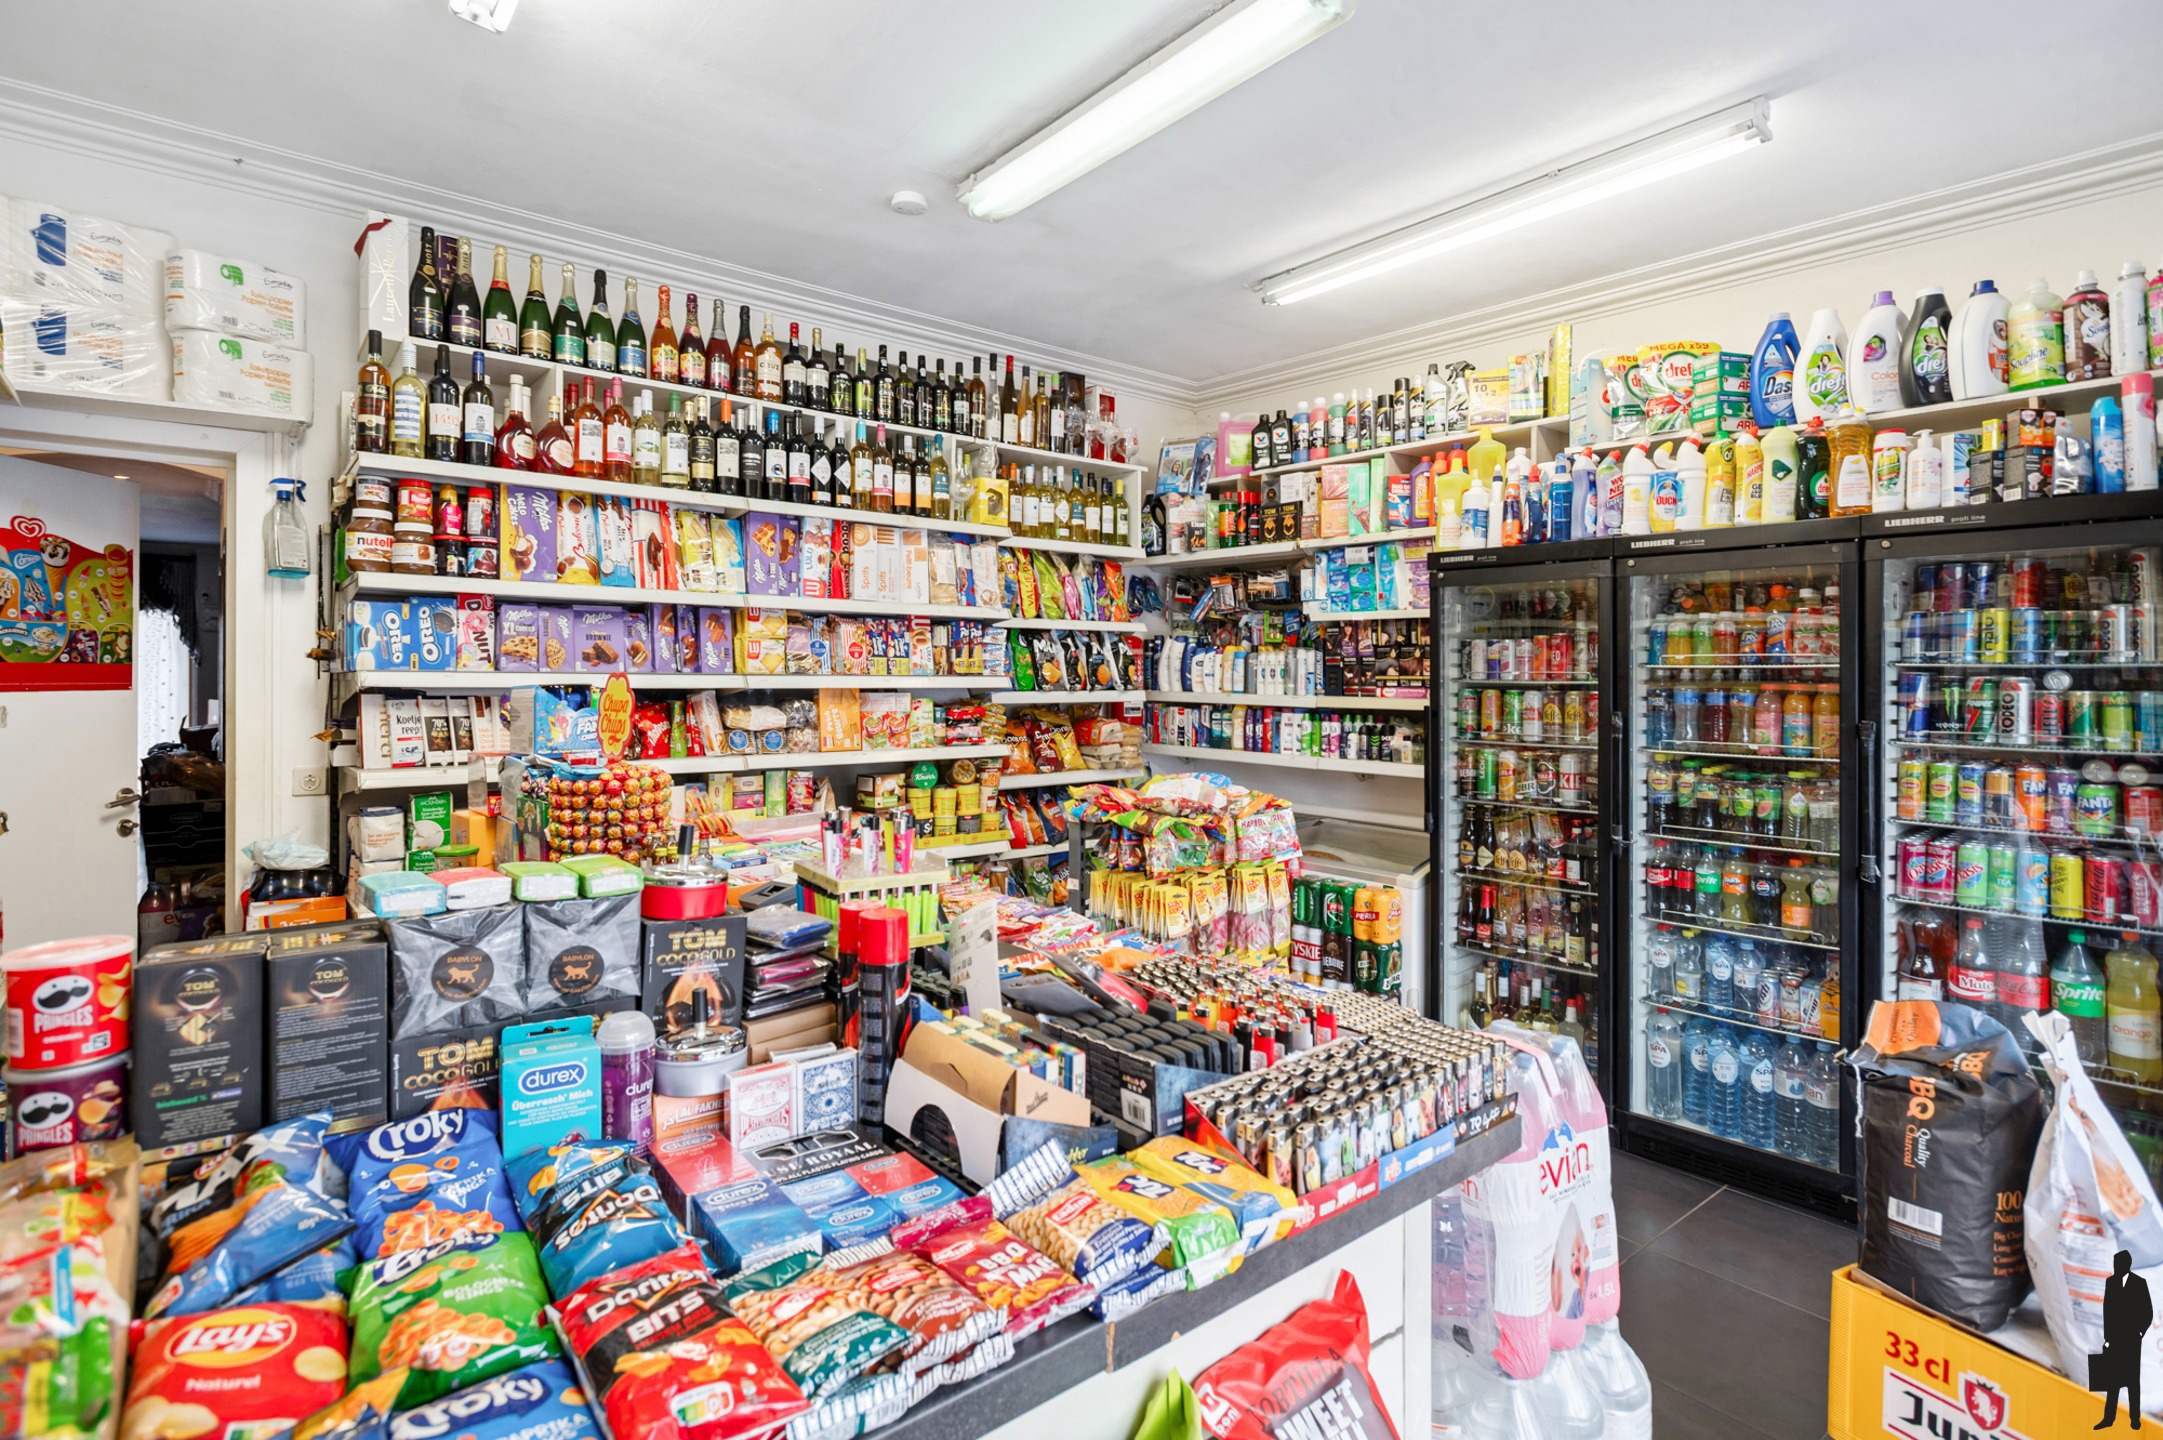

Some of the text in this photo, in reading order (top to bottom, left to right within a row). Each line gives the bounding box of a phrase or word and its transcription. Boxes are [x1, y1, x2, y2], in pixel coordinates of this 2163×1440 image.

[263, 277, 294, 290] Everyday
[262, 350, 291, 362] Everyday
[1650, 342, 1686, 351] MEGA
[759, 361, 780, 371] CRUZ
[1656, 496, 1677, 506] DUCK
[1884, 514, 1945, 528] LIEBHERR
[1631, 539, 1675, 549] LIEBHERR
[1440, 554, 1474, 564] LIEBHERR
[861, 566, 871, 590] Sprits
[382, 610, 403, 664] OREO
[418, 605, 438, 663] OREO
[603, 694, 628, 712] Chupa
[2001, 693, 2016, 735] RODEO
[431, 719, 448, 728] 70%
[600, 715, 627, 744] Chups
[2077, 796, 2114, 809] FANTA
[668, 928, 727, 952] TOM
[1291, 939, 1321, 960] YSKIE
[446, 955, 483, 964] BABYLON
[561, 953, 595, 963] BABYLON
[656, 948, 736, 967] COCOGOLD
[184, 980, 217, 992] TOM
[315, 969, 345, 981] TOM
[1958, 974, 1995, 992] Mate
[2055, 982, 2105, 1002] Sprite
[33, 1005, 95, 1034] PRINGLES
[2112, 1024, 2152, 1038] Orange
[417, 1036, 494, 1071] TOM
[1650, 1043, 1667, 1055] SPA
[403, 1058, 499, 1090] COCOGOL
[526, 1067, 581, 1091] durex
[569, 1088, 593, 1101] Mich
[18, 1122, 74, 1147] PRINGLES
[368, 1108, 465, 1161] Croky
[1903, 1124, 1917, 1168] Charcoal
[805, 1142, 878, 1167] ROYAAL
[1916, 1127, 1932, 1168] Quality
[800, 1161, 833, 1177] PLASTIC
[1180, 1151, 1223, 1175] TUC
[1539, 1141, 1591, 1196] evian
[562, 1167, 623, 1214] BITS
[1126, 1175, 1174, 1199] TUC
[1996, 1191, 2023, 1211] 100
[555, 1185, 660, 1251] Doritos
[976, 1241, 1029, 1270] BBQ
[626, 1290, 705, 1343] BITS
[173, 1319, 290, 1356] Lay's
[1885, 1330, 1951, 1386] 33 cl
[390, 1377, 544, 1440] Croky
